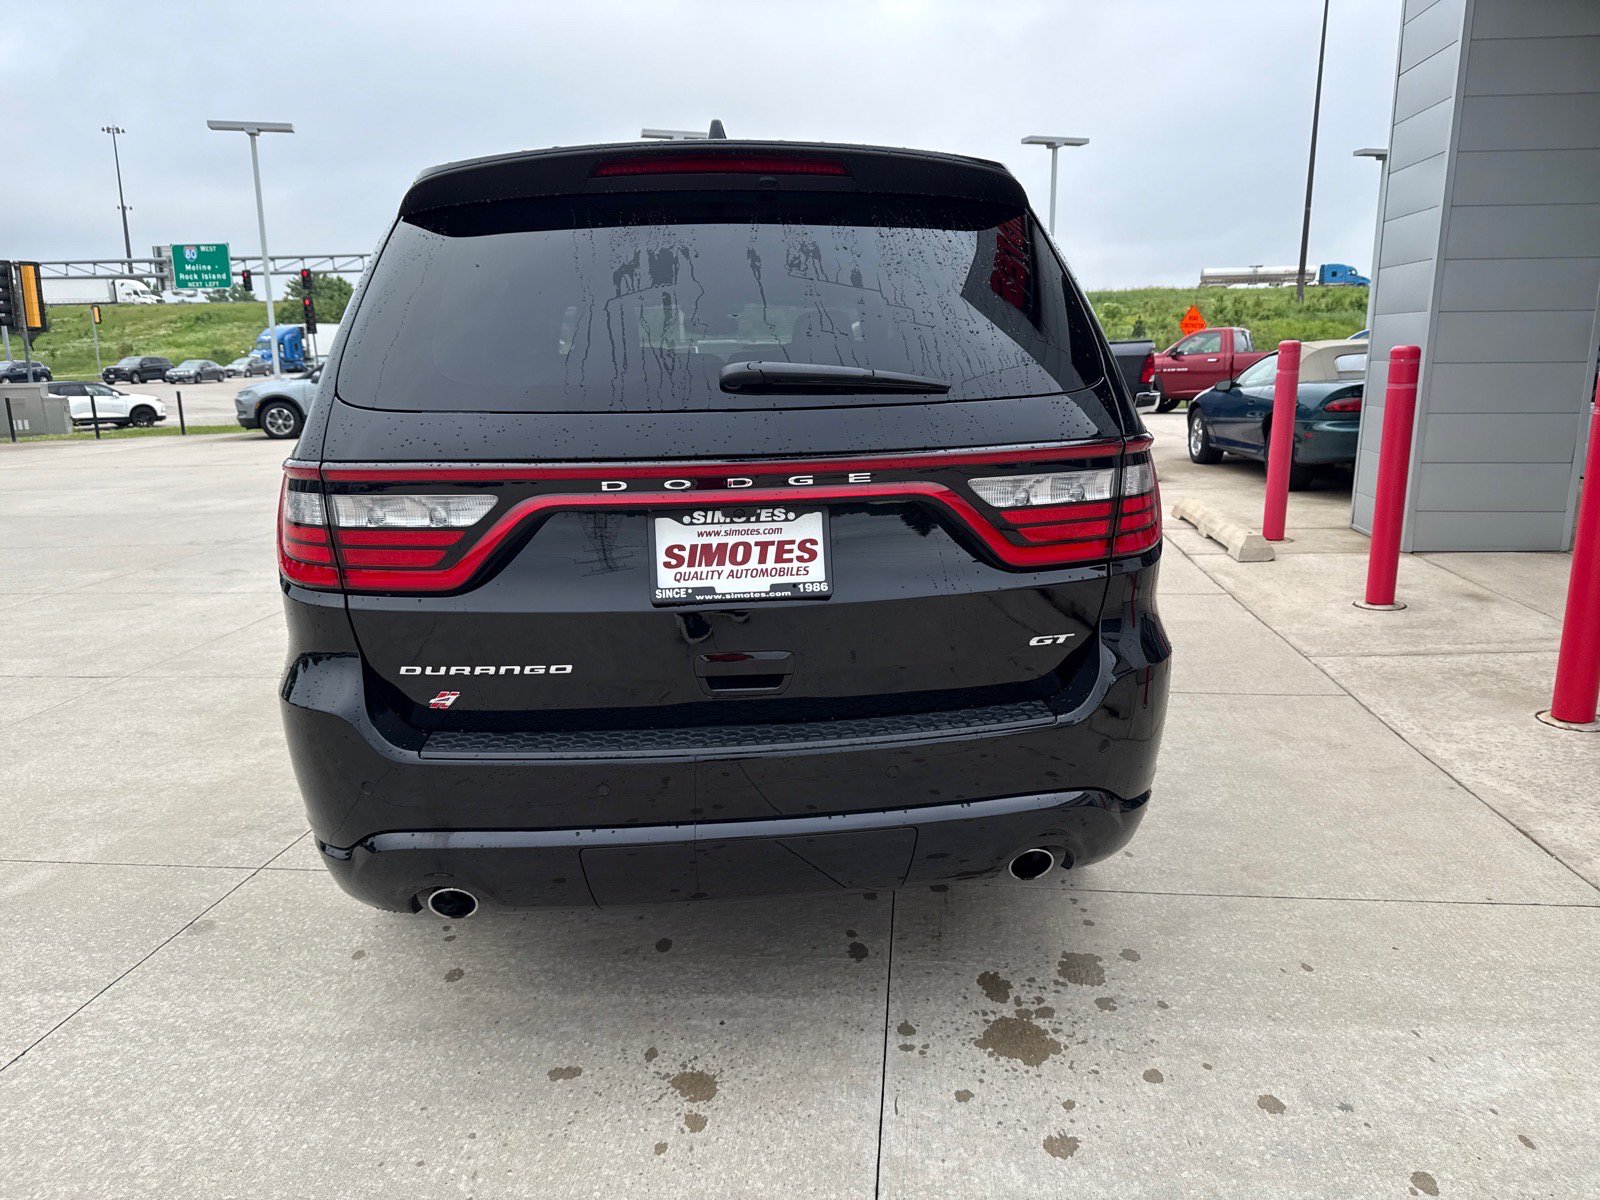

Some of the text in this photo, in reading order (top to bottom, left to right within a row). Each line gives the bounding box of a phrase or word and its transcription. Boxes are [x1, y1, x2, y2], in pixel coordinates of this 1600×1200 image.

[185, 250, 198, 259] 80
[179, 272, 227, 280] Rock Island
[601, 472, 872, 492] DODGE
[692, 508, 786, 524] SIMES
[697, 526, 783, 538] www.simotes.com
[662, 538, 819, 569] SIMOTES
[674, 566, 810, 583] QUALITY AUTOMOBILES
[655, 582, 829, 599] SINCE 1986
[695, 590, 792, 600] www.simotes.com
[1029, 633, 1076, 646] GT
[399, 664, 574, 676] DURANGO
